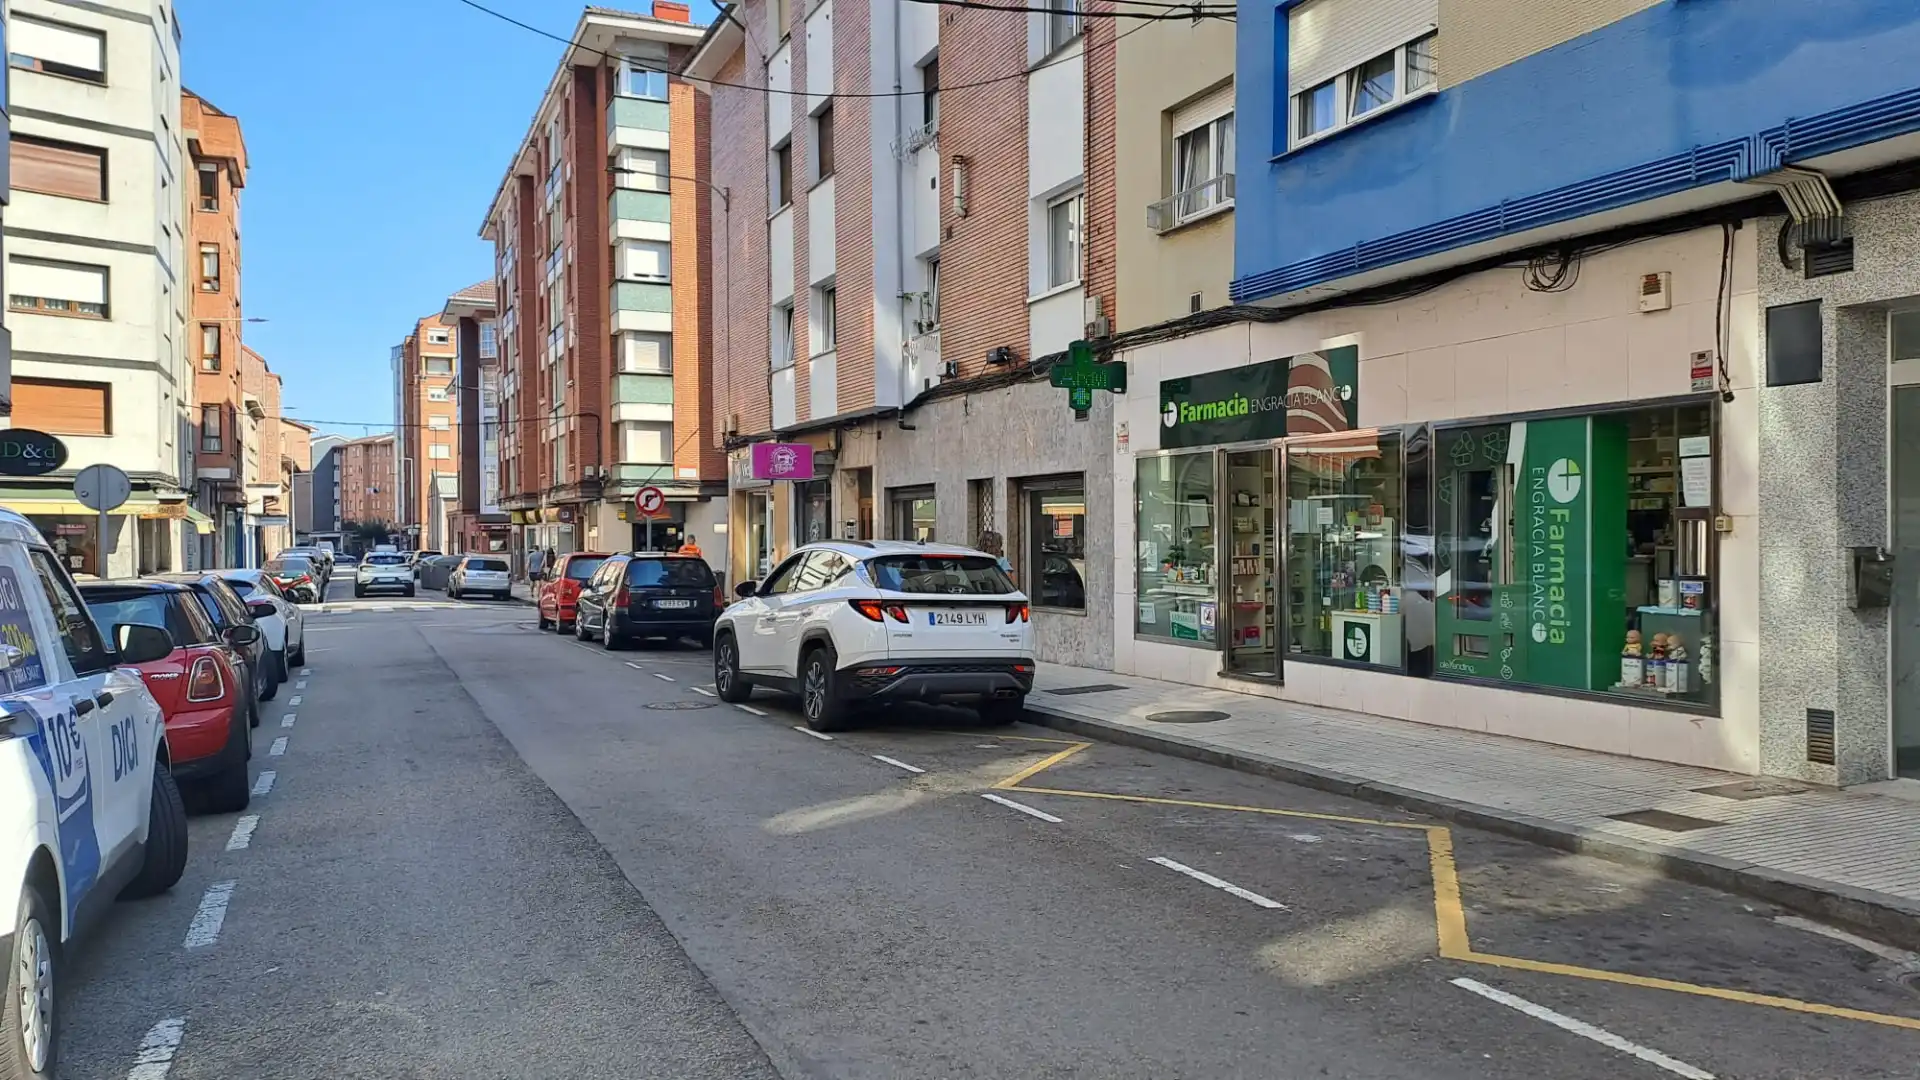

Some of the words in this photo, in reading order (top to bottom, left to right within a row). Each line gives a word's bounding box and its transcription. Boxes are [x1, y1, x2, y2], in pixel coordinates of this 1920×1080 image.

[1180, 392, 1249, 424] Farmacia
[1251, 392, 1300, 414] ENGRACIA
[3, 441, 57, 459] D&d
[1532, 466, 1545, 557] ENGRACIA
[1549, 508, 1571, 645] Farmacia
[937, 613, 963, 624] 2149
[966, 612, 985, 624] LYH
[111, 714, 139, 782] DIGI
